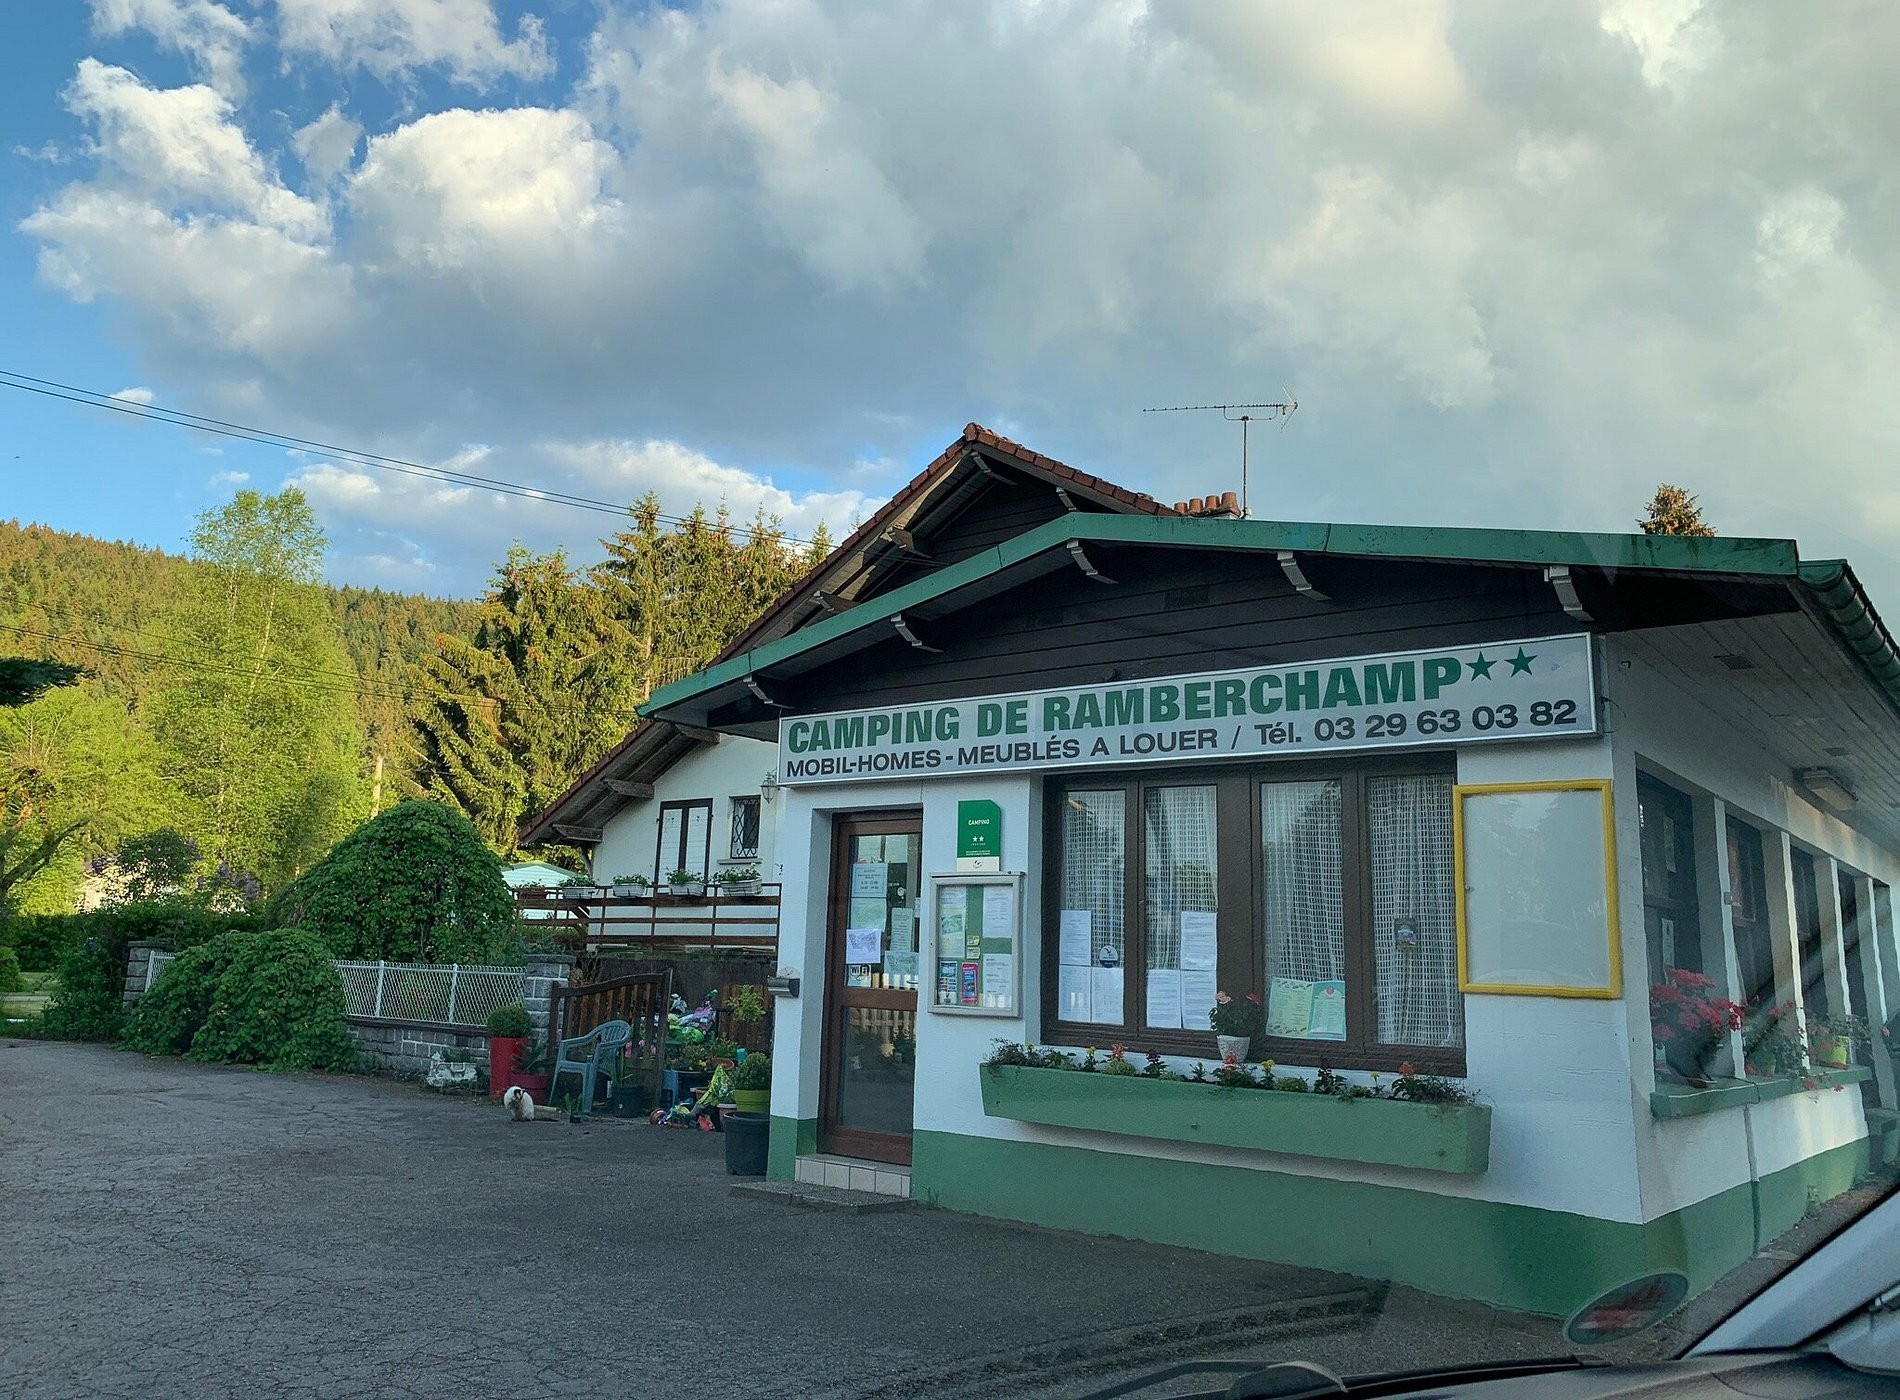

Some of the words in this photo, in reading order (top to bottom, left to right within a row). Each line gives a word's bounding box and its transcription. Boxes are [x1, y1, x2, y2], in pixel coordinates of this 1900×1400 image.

[786, 748, 942, 778] MOBIL-HOMES
[958, 735, 1081, 766] MEUBLÉS
[1090, 737, 1110, 757] A
[1120, 728, 1218, 755] LOUER
[1254, 722, 1302, 746] Tél.
[1314, 717, 1356, 742] 03
[1365, 713, 1407, 738] 29
[1416, 709, 1461, 735] 63
[1471, 704, 1518, 731] 03
[1530, 699, 1577, 726] 82
[788, 706, 960, 754] CAMPING
[977, 700, 1028, 738] DE
[1043, 656, 1462, 732] RAMBERCHAMP
[968, 818, 990, 826] CAMPING
